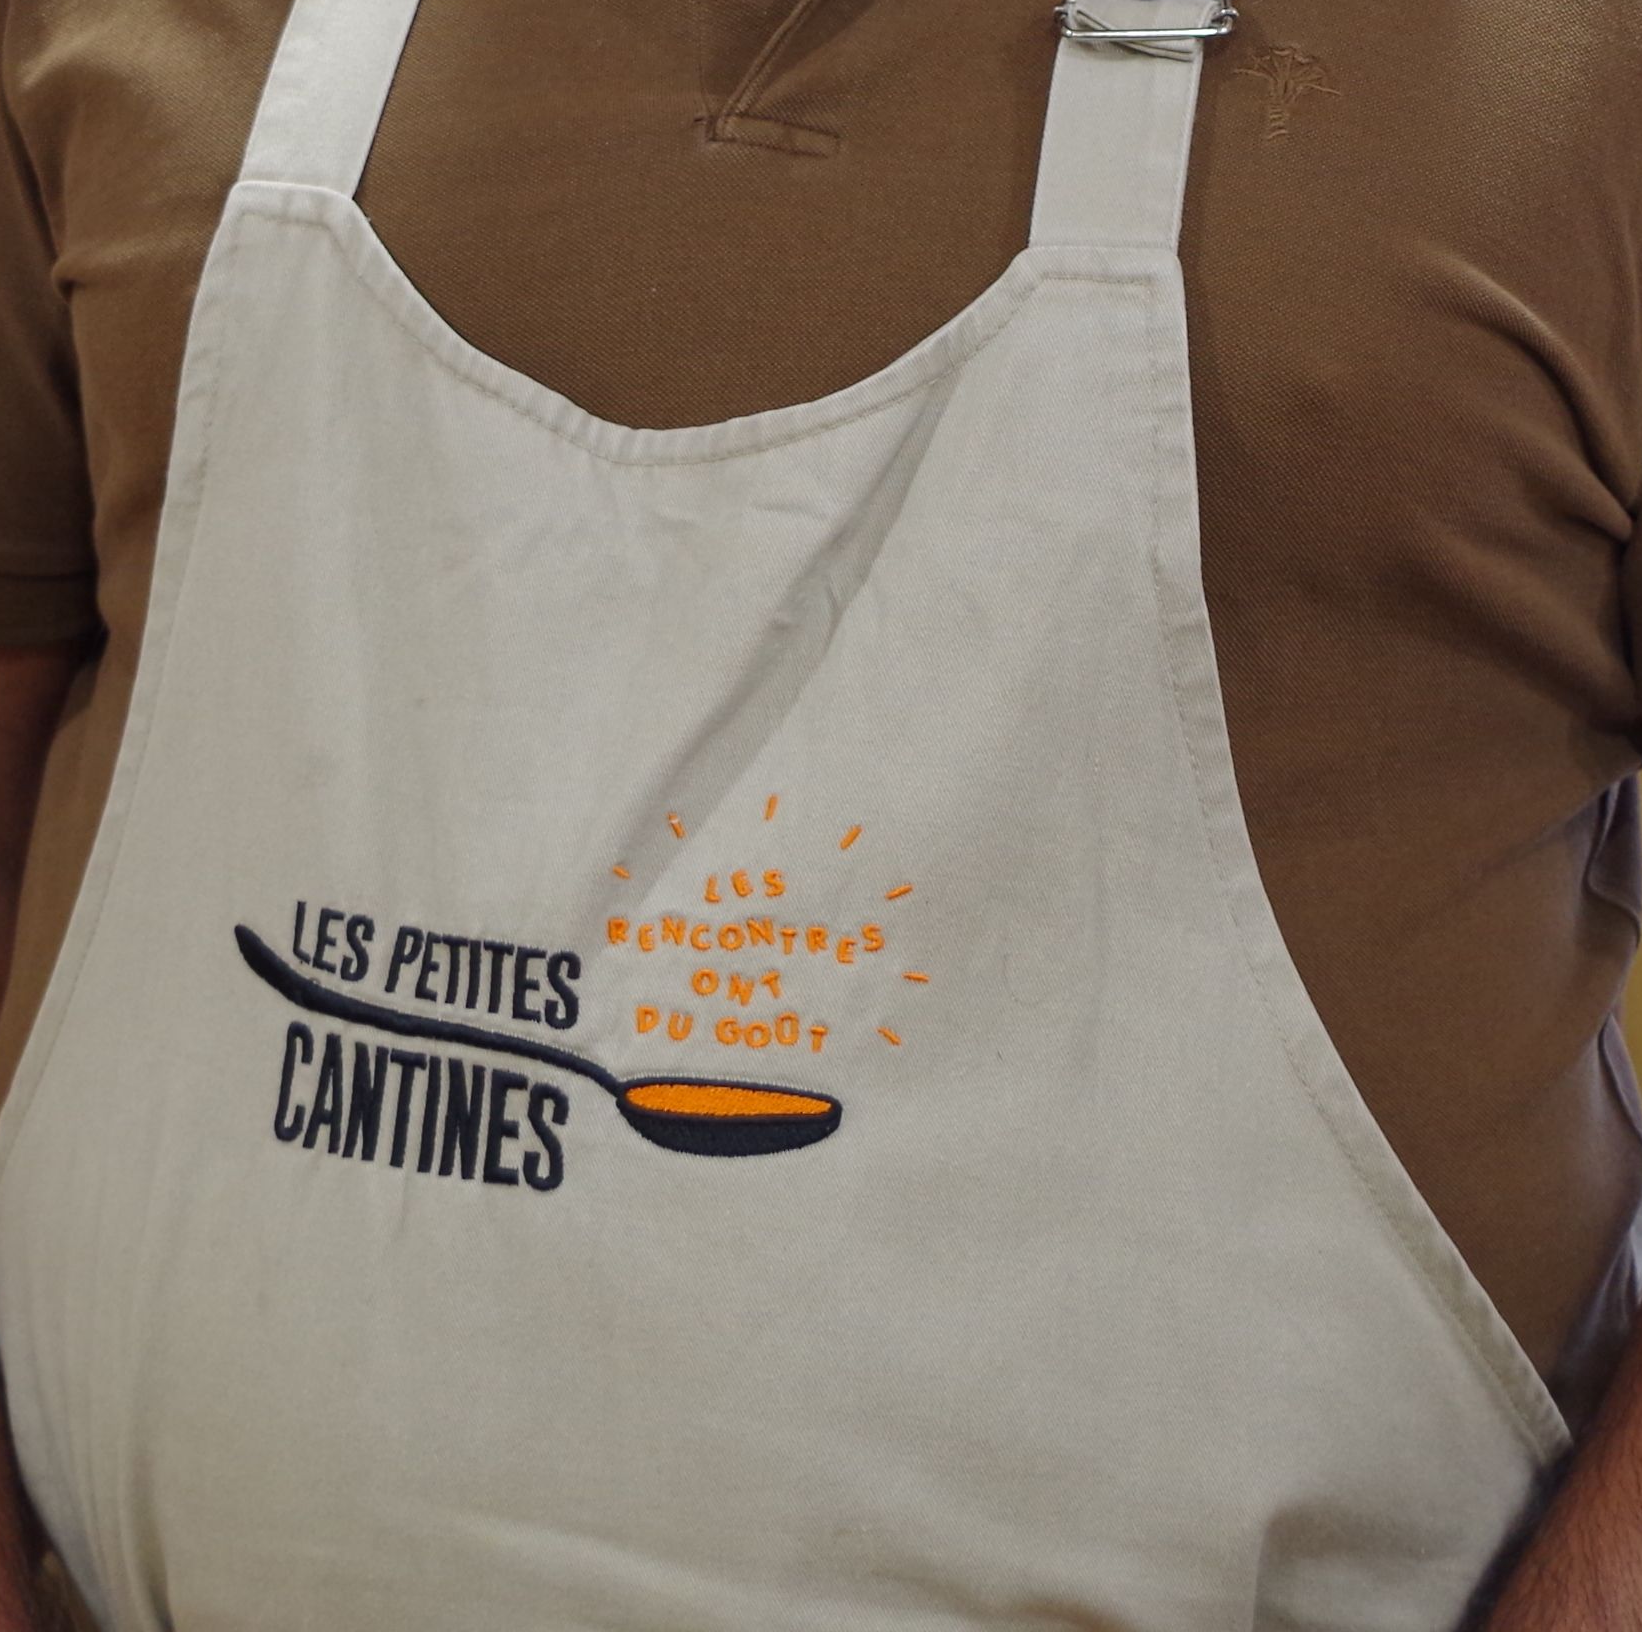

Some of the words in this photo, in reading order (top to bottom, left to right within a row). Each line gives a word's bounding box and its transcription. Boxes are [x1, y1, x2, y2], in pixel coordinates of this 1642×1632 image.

[704, 870, 786, 904] LES
[607, 916, 886, 965] RENCONTRES
[292, 900, 375, 982] LES
[384, 926, 581, 1030] PETITES
[691, 968, 782, 1007] ONT
[635, 1005, 694, 1042] DU
[273, 1021, 570, 1193] CANTINES
